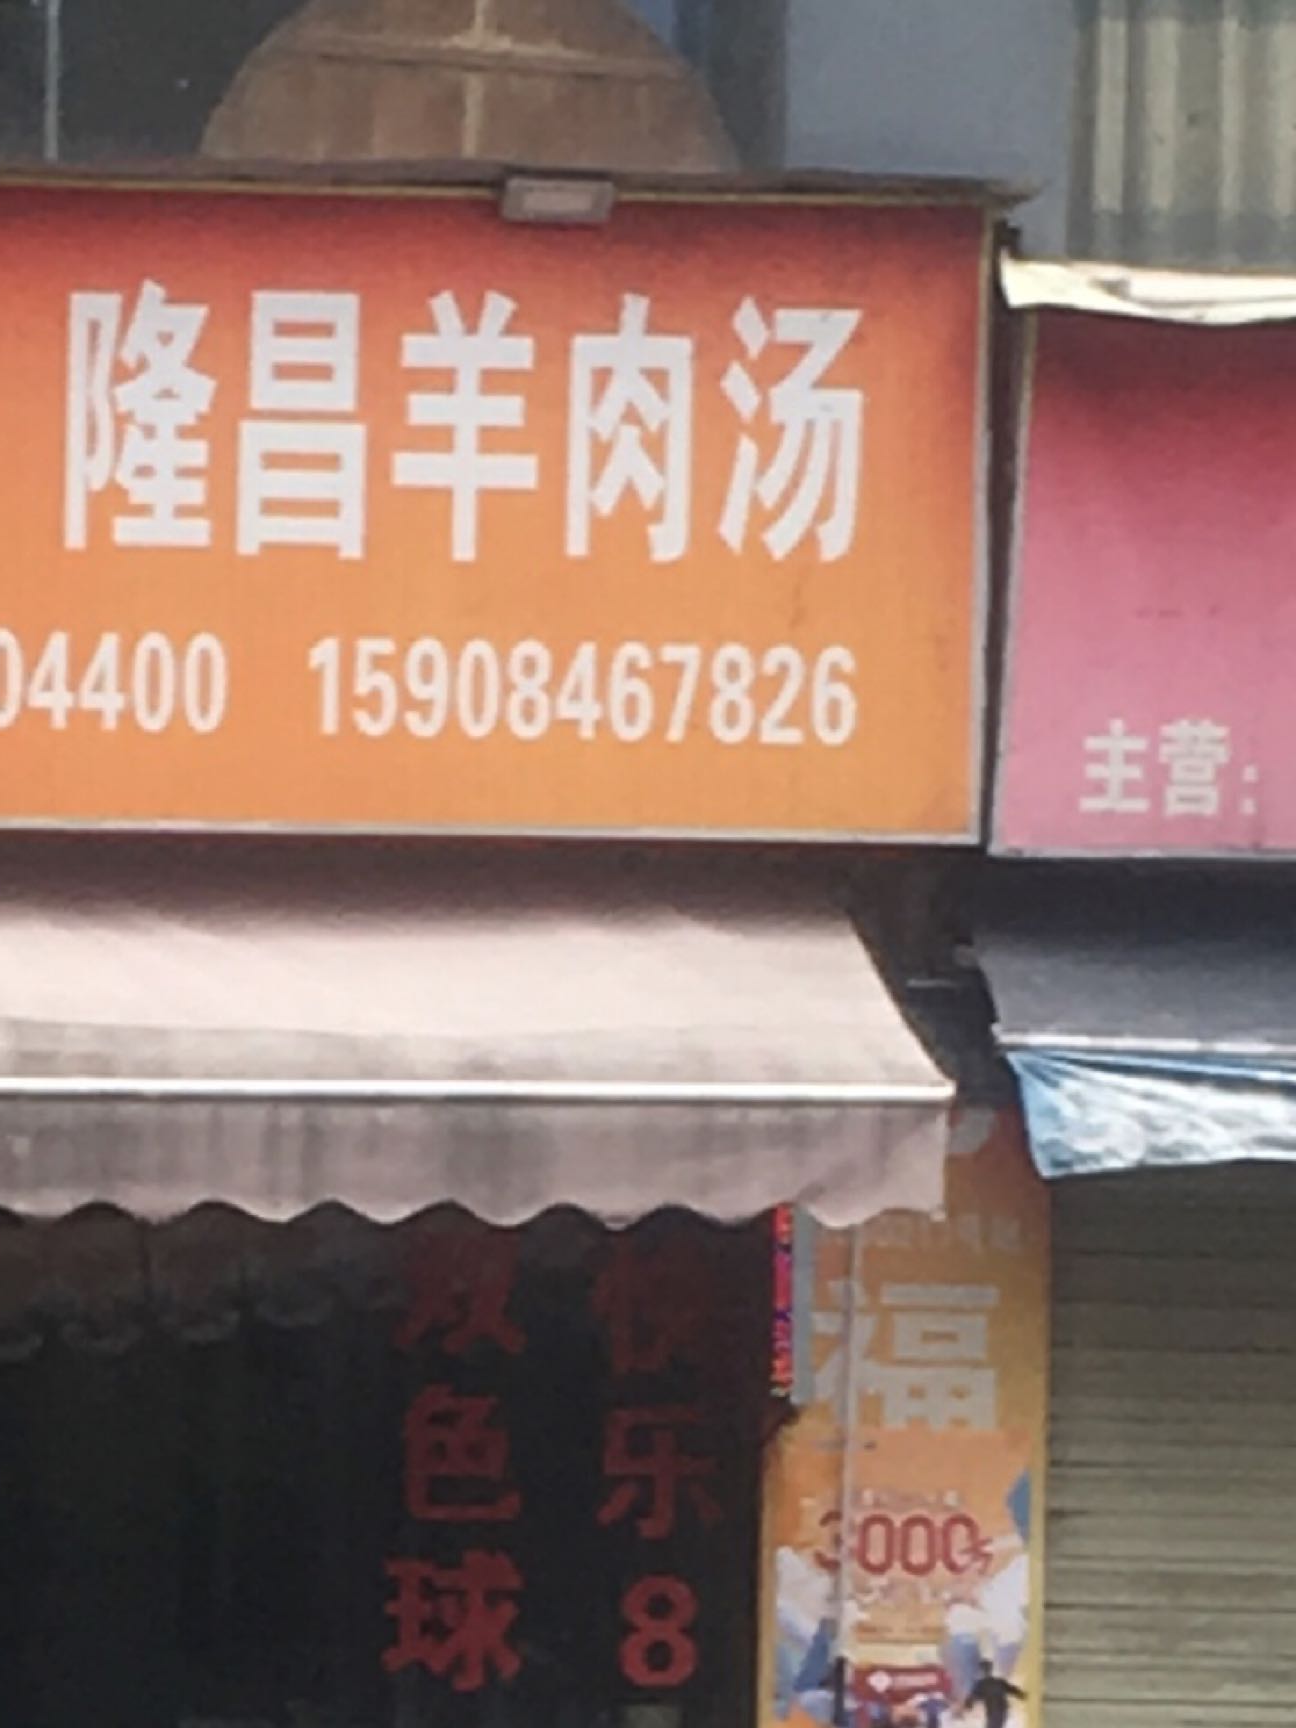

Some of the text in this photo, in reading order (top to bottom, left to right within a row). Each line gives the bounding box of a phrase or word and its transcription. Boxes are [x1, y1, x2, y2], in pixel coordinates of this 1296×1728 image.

[64, 280, 866, 561] 隆昌羊肉汤
[308, 638, 858, 744] 15908467826
